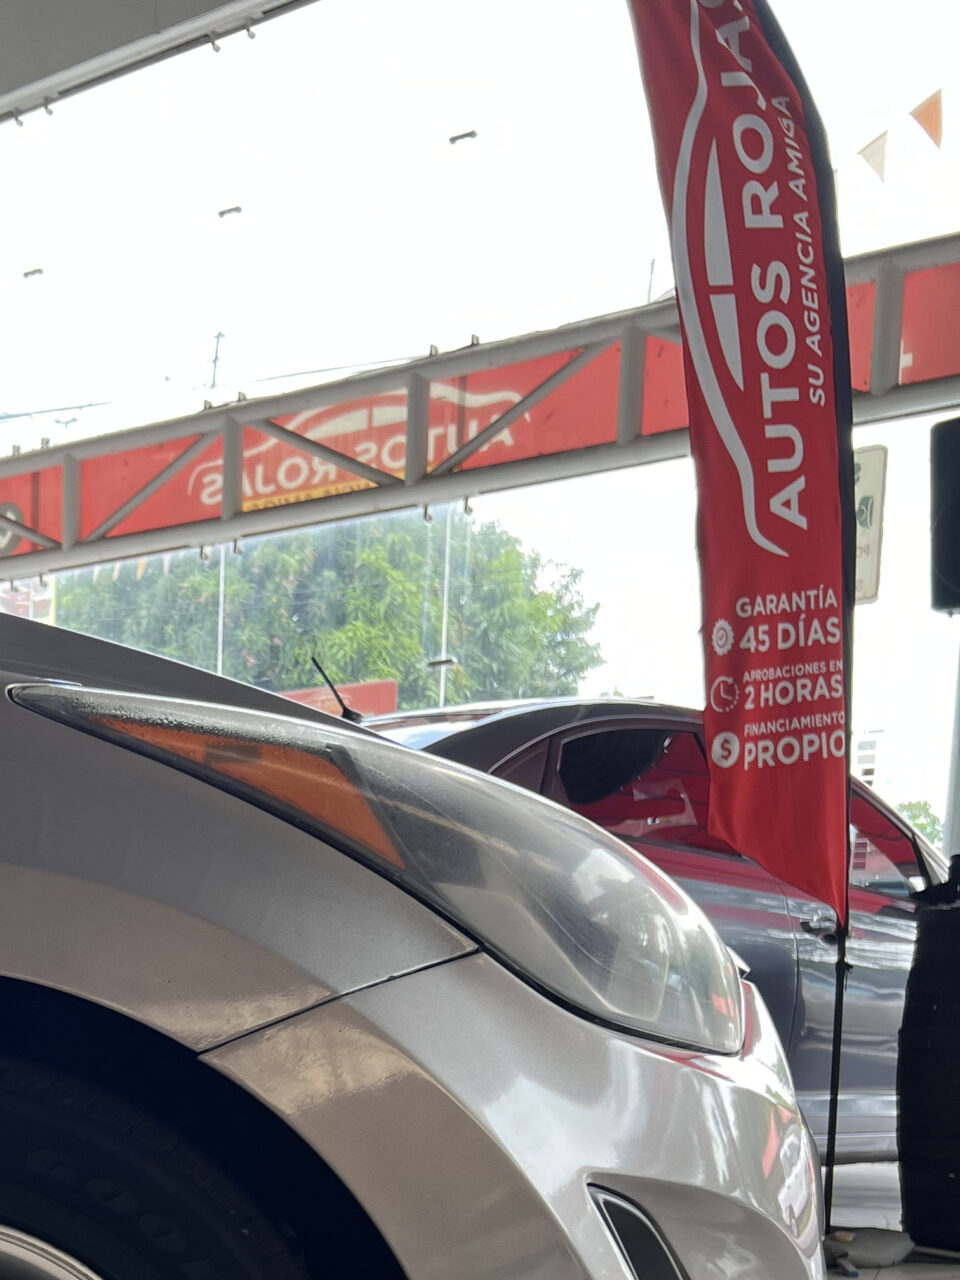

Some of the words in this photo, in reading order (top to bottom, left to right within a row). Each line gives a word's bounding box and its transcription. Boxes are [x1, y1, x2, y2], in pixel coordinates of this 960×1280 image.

[771, 95, 808, 202] AMIGA
[794, 210, 822, 357] AGENCIA
[750, 260, 808, 531] AUTOS
[809, 363, 826, 407] SU
[735, 584, 838, 619] GARANTÍA
[738, 623, 771, 654] 45
[776, 612, 842, 651] DÍAS
[742, 660, 827, 684] APROBACIONES
[829, 658, 844, 673] EN
[743, 684, 755, 711] 2
[759, 673, 844, 709] HORAS
[743, 710, 846, 738] FINANCIAMIENTO
[743, 729, 846, 772] PROPIO
